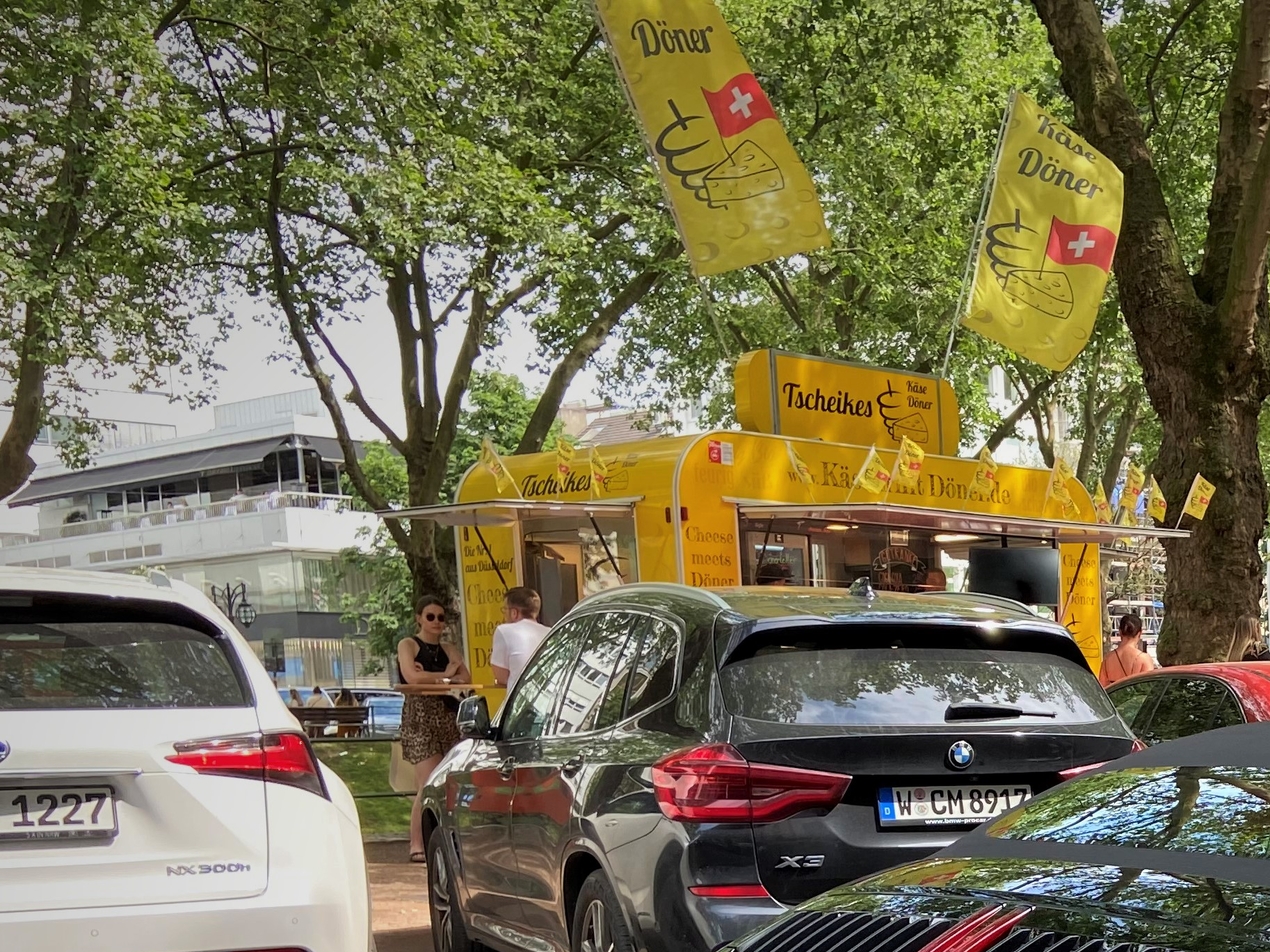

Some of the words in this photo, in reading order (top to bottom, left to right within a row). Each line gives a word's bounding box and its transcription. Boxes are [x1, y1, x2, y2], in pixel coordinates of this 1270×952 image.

[631, 18, 713, 58] Döner
[1037, 114, 1097, 165] Käse
[1017, 147, 1103, 199] Döner
[905, 380, 927, 394] Käse
[782, 382, 872, 418] Tscheikes
[907, 397, 933, 410] Döner
[685, 525, 733, 544] Cheese
[465, 564, 477, 573] aus
[480, 557, 513, 573] Düssldorf
[692, 553, 732, 566] meets
[1063, 554, 1096, 569] Chese
[467, 583, 506, 605] Chee
[12, 792, 107, 827] 1227
[896, 790, 912, 815] W
[930, 787, 964, 815] CM
[774, 854, 825, 869] X3
